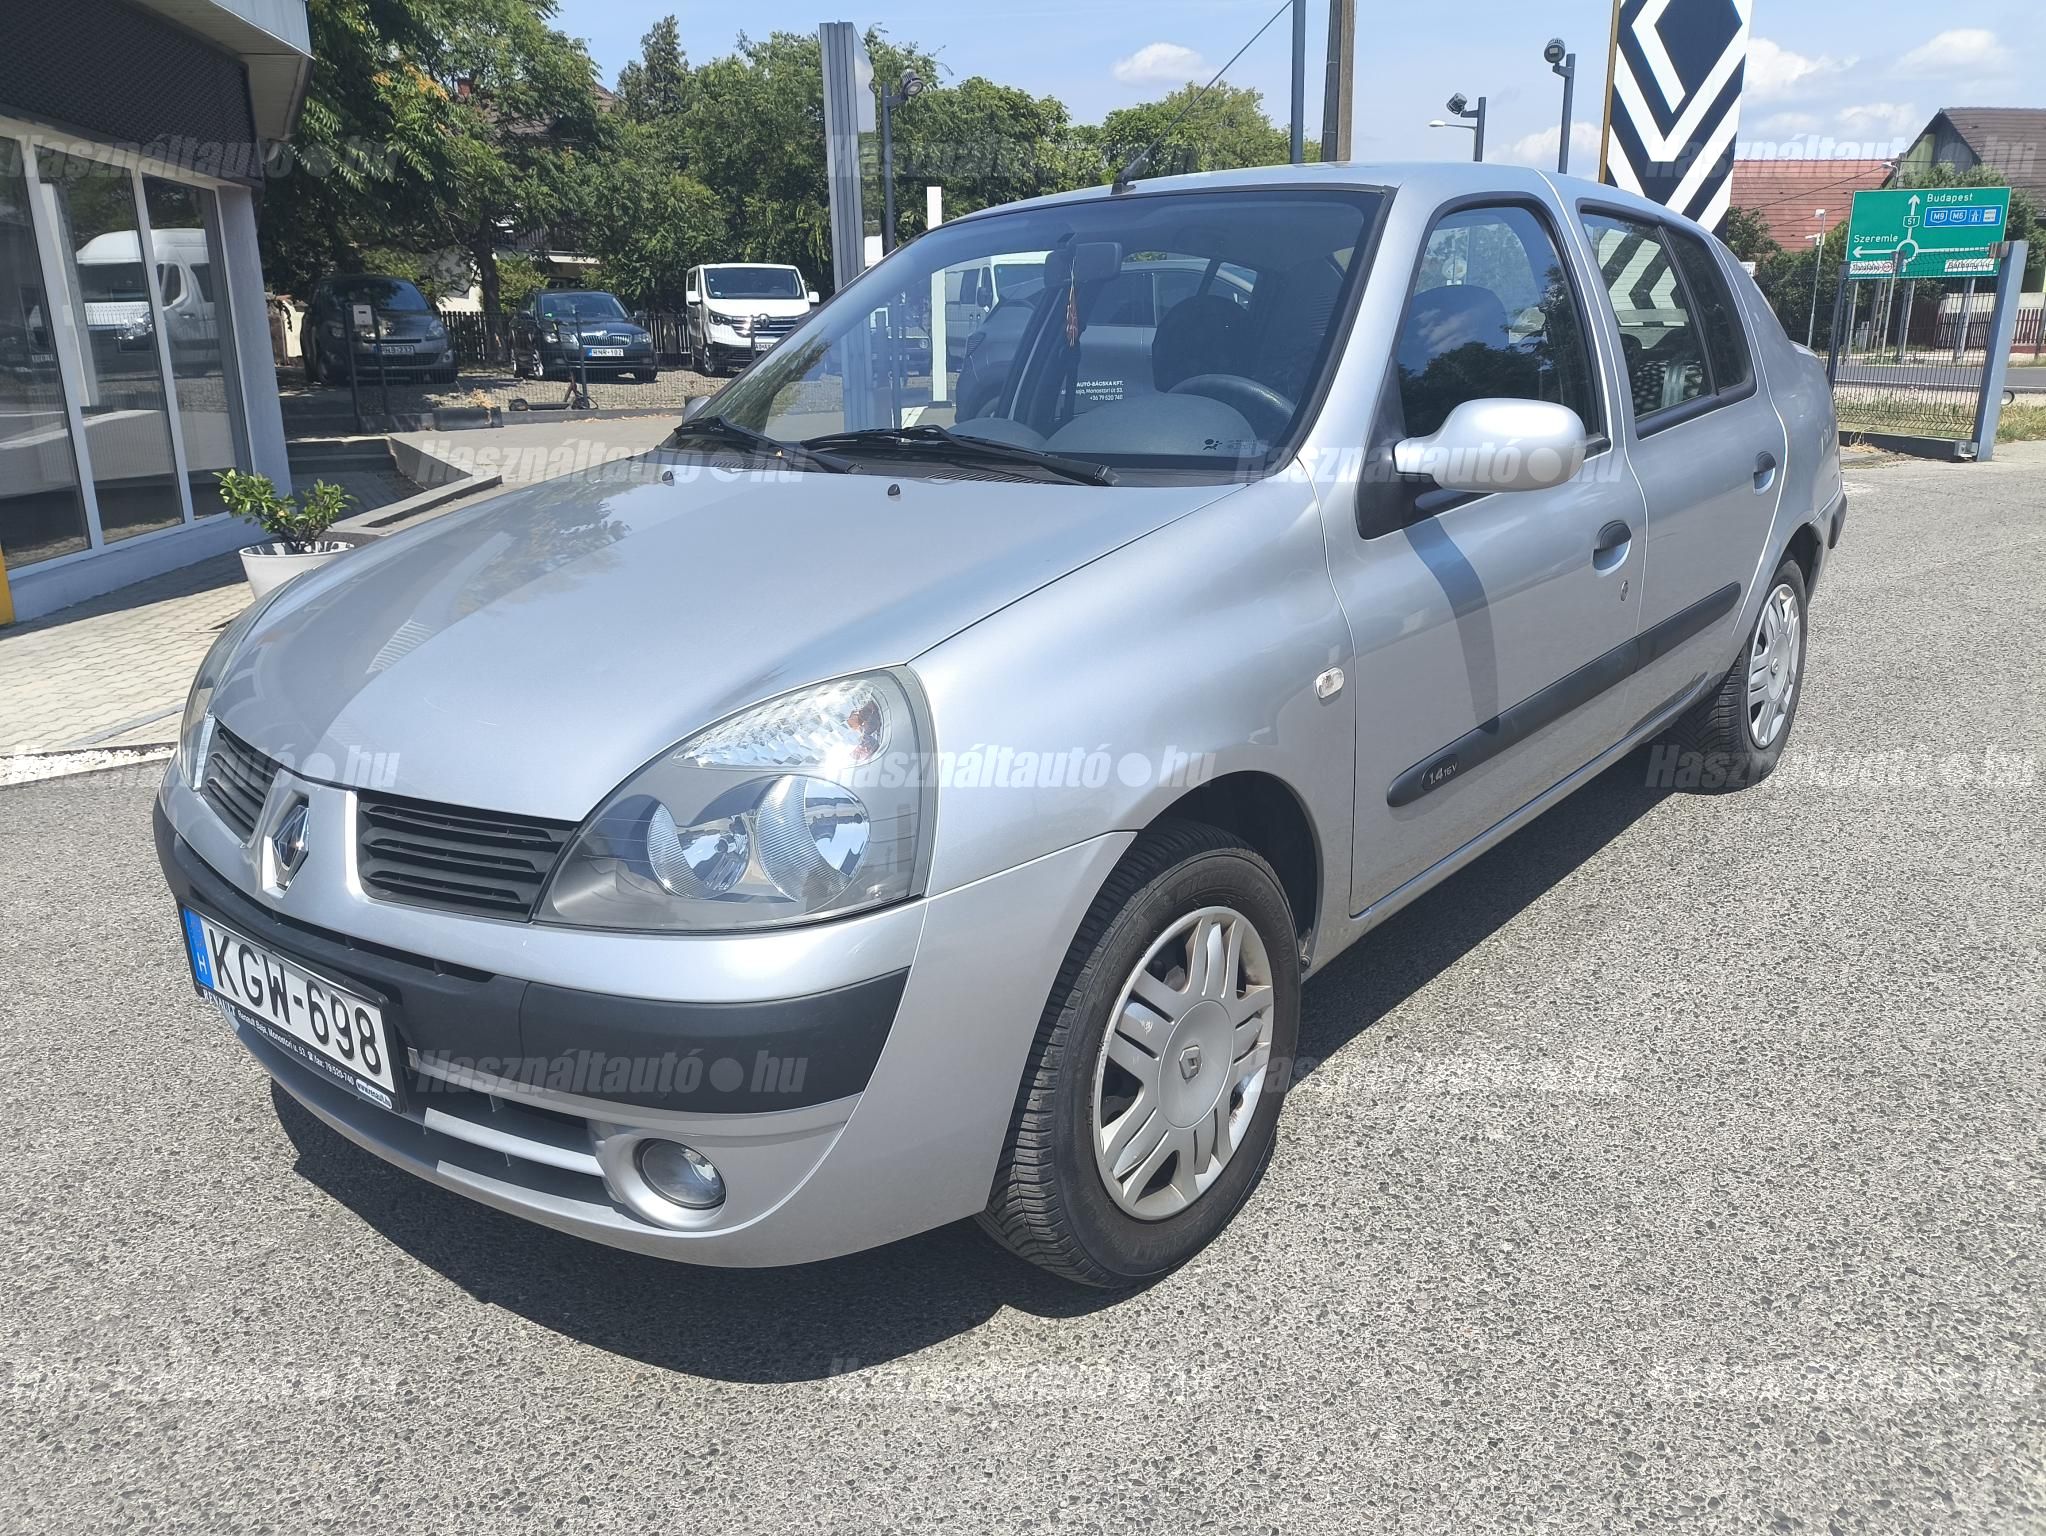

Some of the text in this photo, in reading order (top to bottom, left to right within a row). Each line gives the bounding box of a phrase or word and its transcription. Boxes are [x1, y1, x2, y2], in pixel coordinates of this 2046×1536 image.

[1927, 192, 1973, 204] Budapest
[1933, 212, 1945, 220] M9
[1853, 234, 1899, 243] Szeremle
[1443, 761, 1458, 777] 16V
[198, 959, 208, 975] H
[203, 988, 236, 1016] RENAULT
[208, 926, 382, 1076] KGW-698
